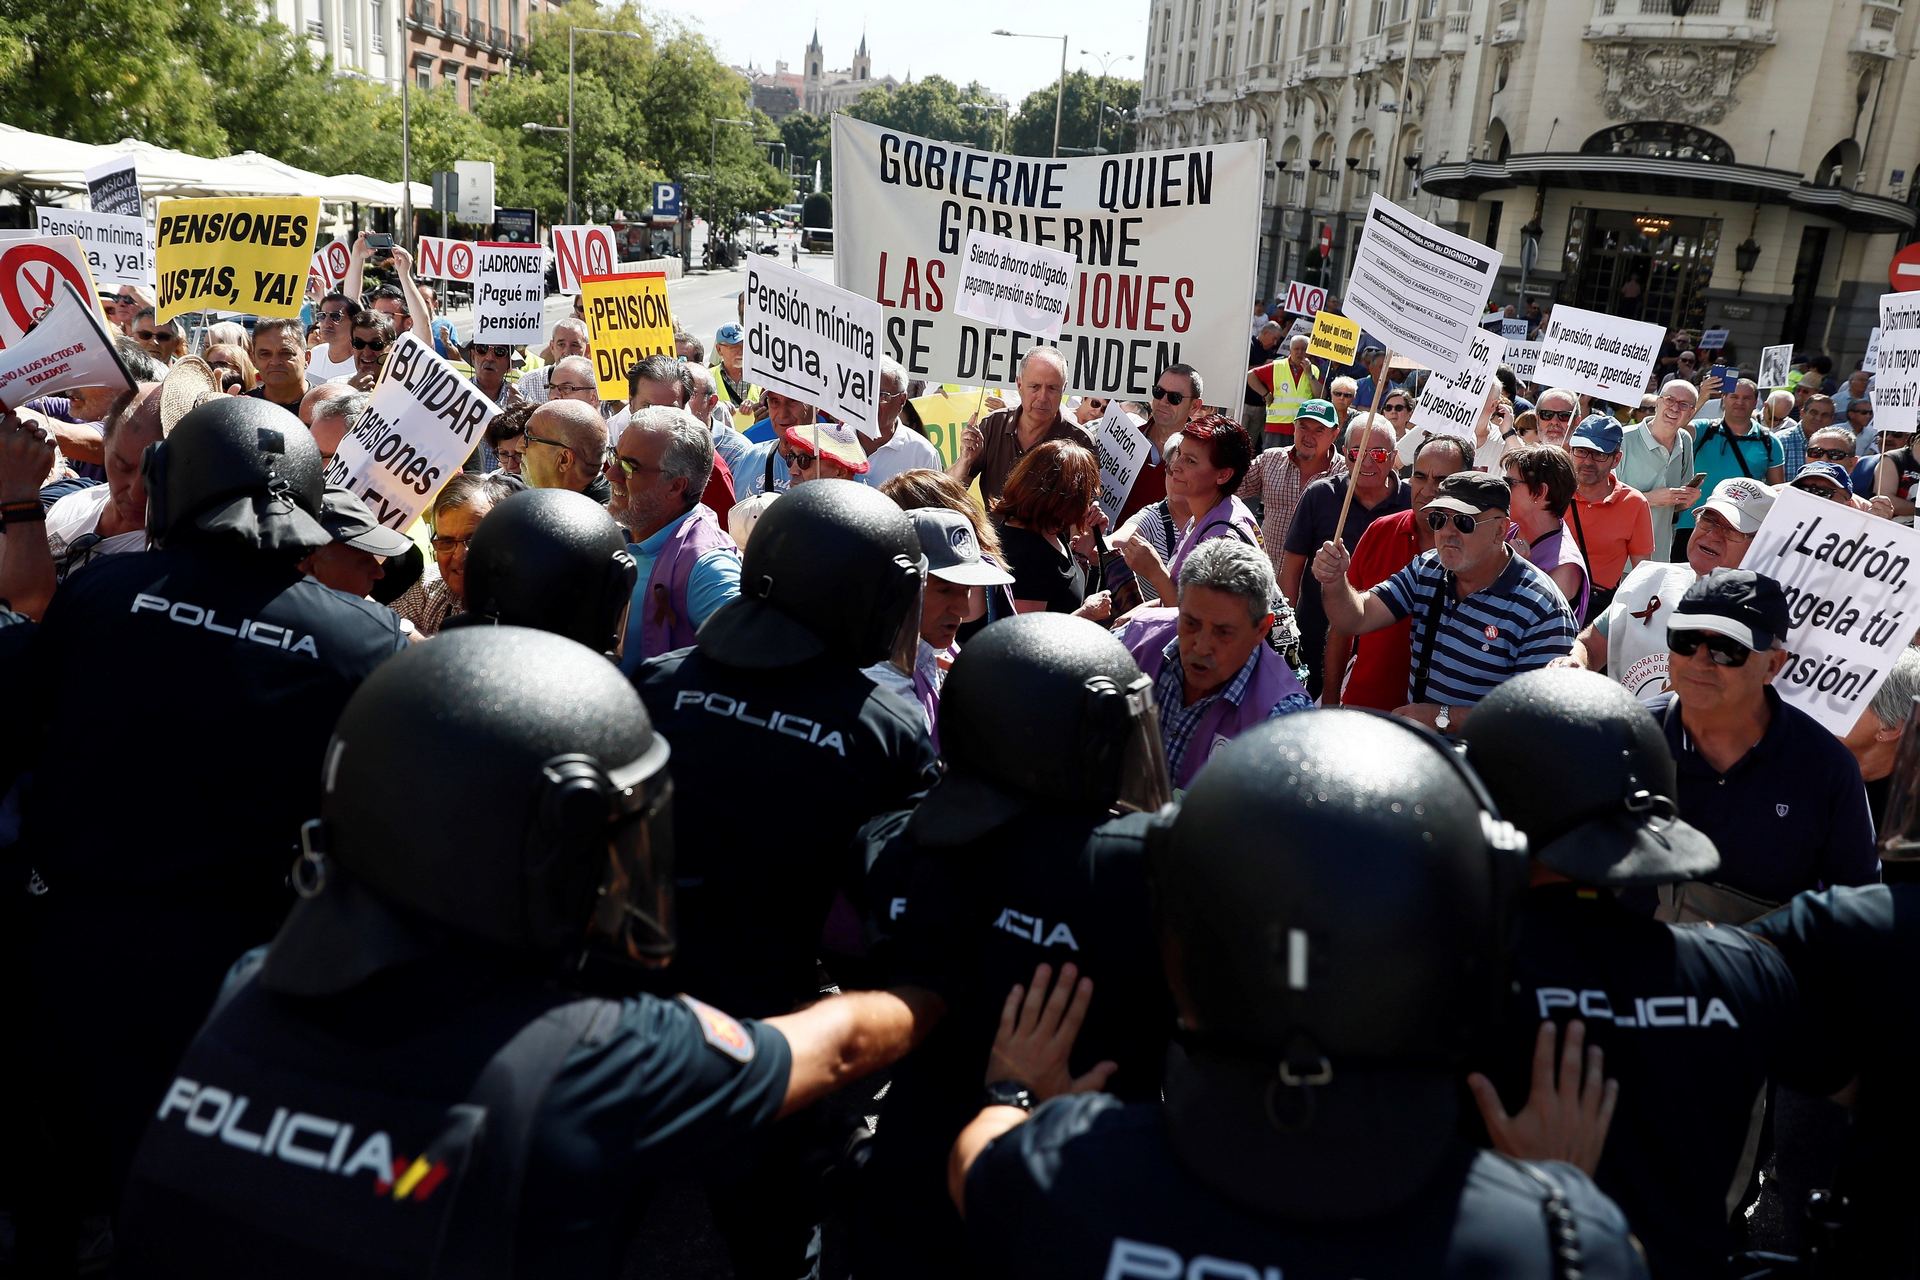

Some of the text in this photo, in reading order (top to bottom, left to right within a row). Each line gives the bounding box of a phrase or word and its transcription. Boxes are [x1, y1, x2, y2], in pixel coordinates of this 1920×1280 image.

[879, 133, 1213, 213] GOBIERNE QUIEN
[658, 185, 675, 209] P
[41, 215, 93, 241] Pensión
[97, 223, 143, 247] mínima
[157, 212, 309, 248] PENSIONES
[114, 252, 144, 273] ya!
[419, 237, 474, 280] NO
[478, 253, 542, 277] ¡LADRONES!
[553, 228, 613, 291] NO
[969, 243, 1069, 290] Siendo ahorro obligado,
[1409, 253, 1439, 274] LABORALES
[1438, 268, 1447, 276] DE
[1446, 271, 1459, 283] 2011
[1424, 239, 1436, 249] POR
[1443, 244, 1479, 266] DIGNIDAD
[158, 265, 299, 309] JUSTAS, YA!
[478, 282, 542, 308] ¡Pagué mi
[877, 250, 1195, 334] LAS IONES
[963, 273, 1064, 315] pagarme pensión es forzoso.
[1285, 282, 1325, 316] NO
[479, 311, 541, 334] pensión!
[589, 286, 670, 341] ¡PENSIÓN
[747, 270, 875, 361] Pensión mínima
[1427, 310, 1435, 318] AL
[1434, 313, 1457, 328] SALARIO
[1502, 323, 1526, 335] ENSIONES
[23, 359, 43, 374] LOS
[40, 347, 75, 368] PACTOS
[72, 342, 87, 354] DE
[885, 316, 936, 375] SE
[1393, 324, 1421, 344] PENSIONES
[1420, 337, 1433, 349] CON
[1432, 344, 1440, 352] EL
[1508, 346, 1520, 358] LA
[1549, 320, 1653, 366] Mi pensión, deuda estatal,
[748, 321, 875, 407] digna, ya!
[1542, 349, 1565, 368] quien
[1564, 355, 1577, 371] no
[1574, 359, 1599, 380] paga,
[380, 338, 488, 444] ¡BLINDAR
[1471, 375, 1487, 396] tú
[1902, 381, 1918, 408] tú?
[1420, 388, 1478, 428] tu pensión!
[342, 405, 440, 496] pensiones
[1104, 415, 1137, 461] ¡Ladrón,
[1117, 466, 1132, 487] tú
[1777, 515, 1911, 594] ¡Ladrón,
[129, 592, 320, 660] POLICIA
[1783, 583, 1905, 649] ngela tú
[1653, 653, 1665, 662] DE
[1780, 650, 1879, 702] nsión!
[673, 689, 846, 757] POLICIA
